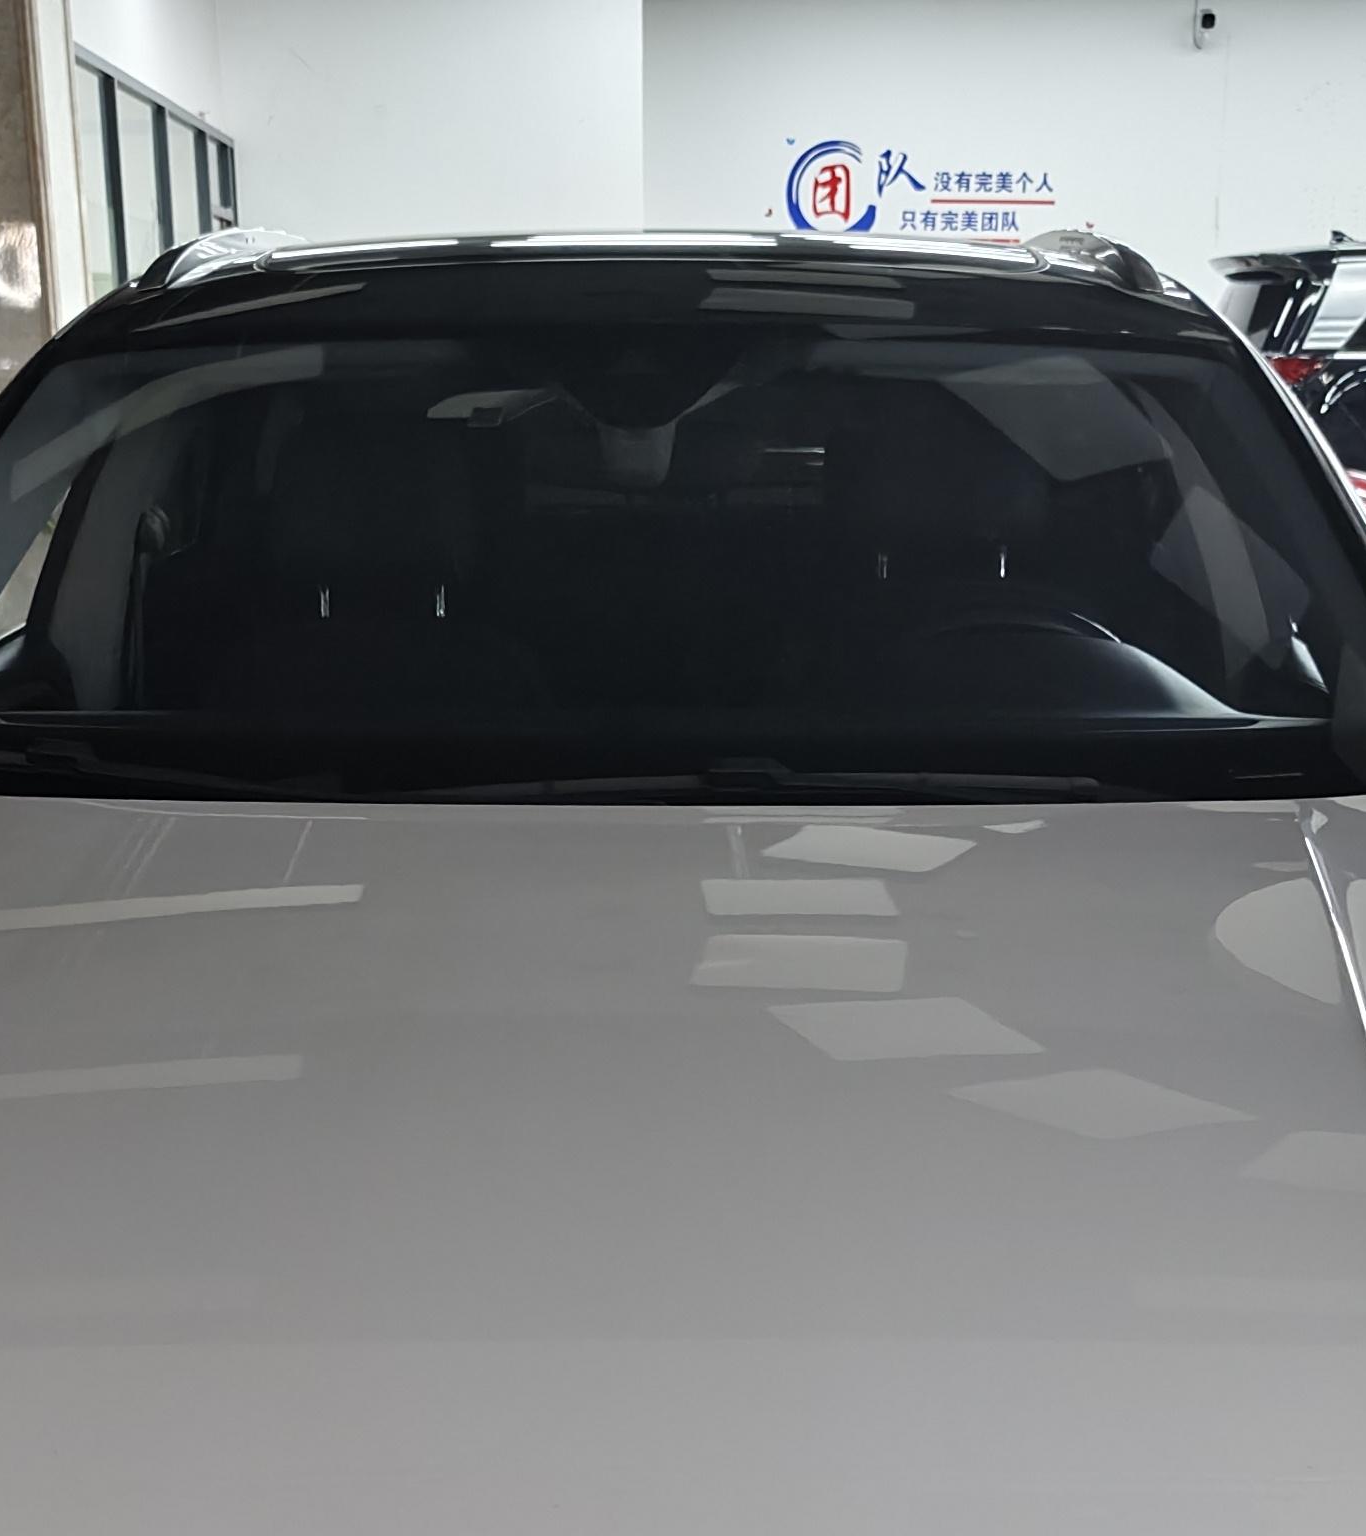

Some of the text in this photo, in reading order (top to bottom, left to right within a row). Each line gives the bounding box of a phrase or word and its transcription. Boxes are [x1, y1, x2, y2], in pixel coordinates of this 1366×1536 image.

[812, 149, 926, 223] 团队
[933, 171, 1054, 194] 没有完美个人
[899, 210, 1020, 232] 只有完美团队
